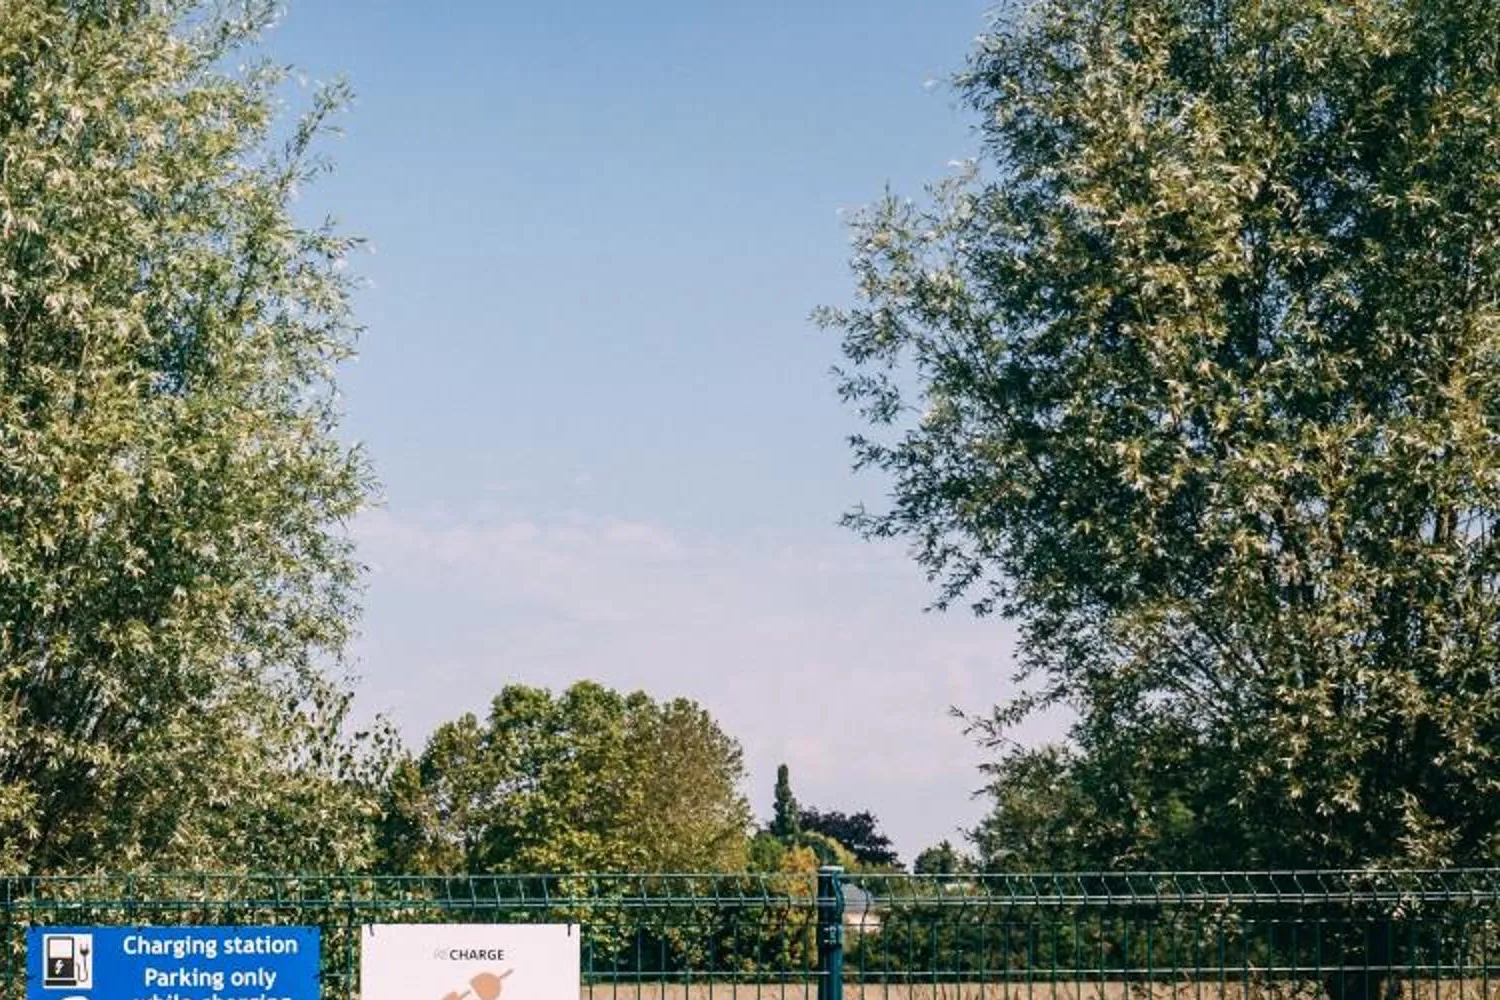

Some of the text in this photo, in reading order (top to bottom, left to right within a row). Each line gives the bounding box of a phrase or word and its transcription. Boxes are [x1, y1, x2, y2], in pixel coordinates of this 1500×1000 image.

[124, 936, 297, 958] Charging station
[145, 968, 276, 990] Parking only
